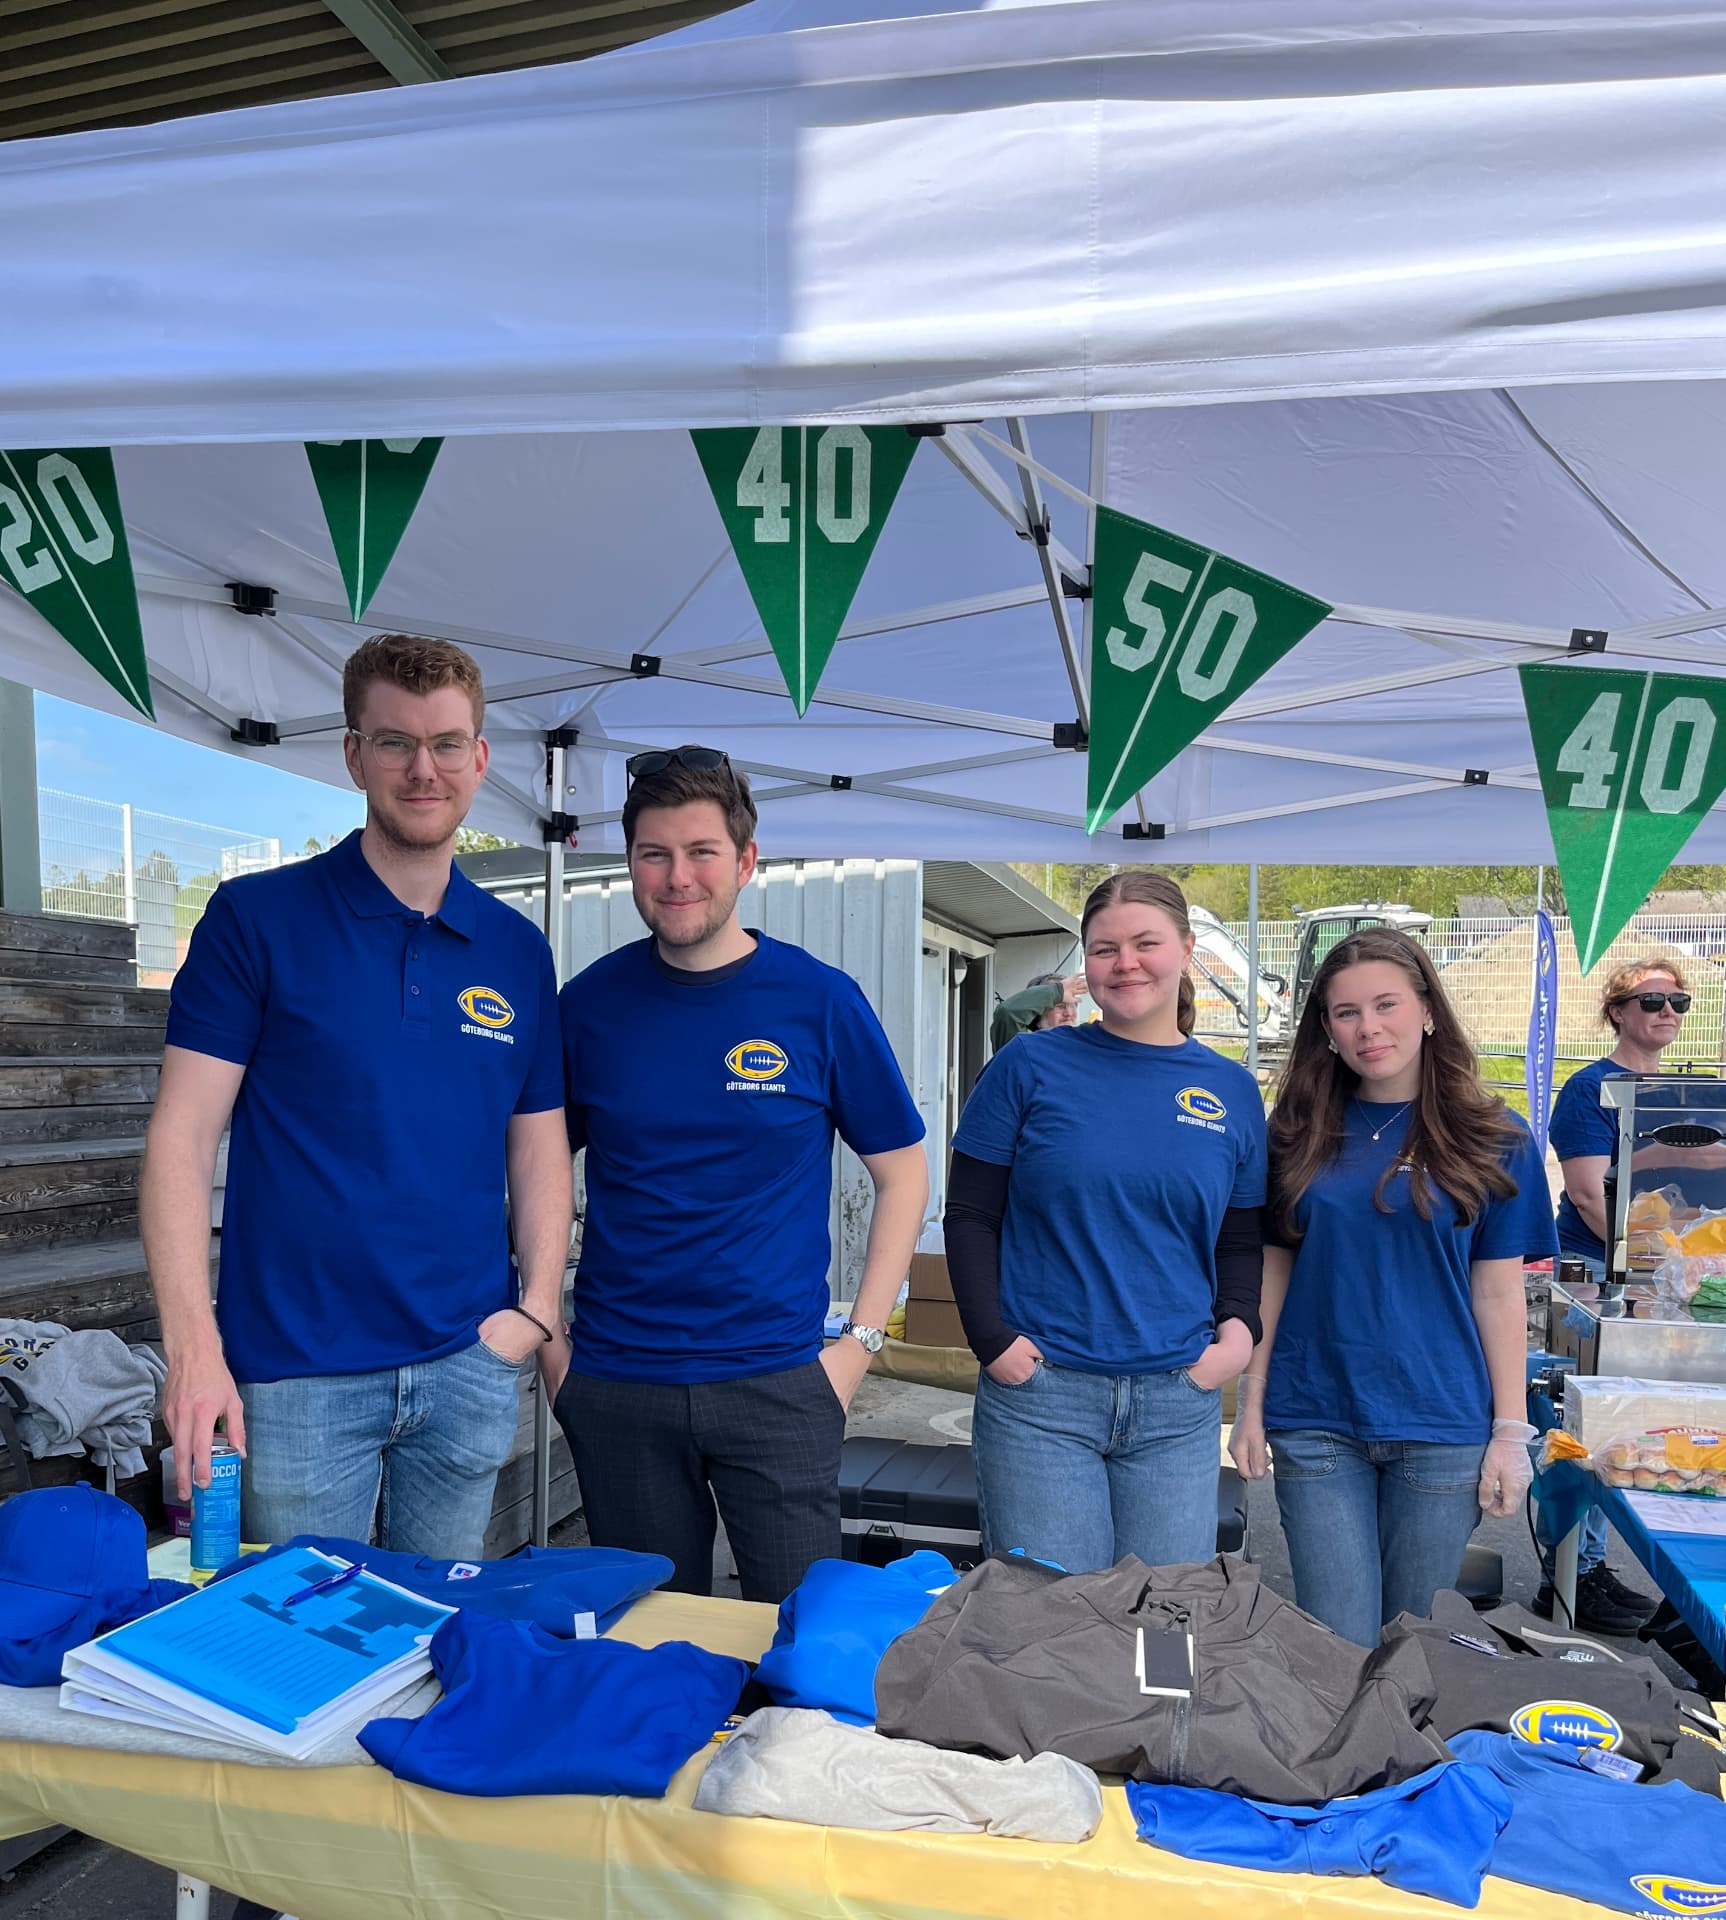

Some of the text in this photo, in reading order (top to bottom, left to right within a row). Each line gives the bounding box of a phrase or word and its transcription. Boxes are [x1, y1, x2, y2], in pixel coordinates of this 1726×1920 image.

[0, 452, 115, 594] 20
[736, 425, 872, 543] 40
[1105, 551, 1258, 702] 50
[1556, 691, 1717, 815] 40
[461, 1023, 514, 1045] GÖTEBORG GIANTS
[726, 1080, 786, 1093] GÖTEBORG GIANTS
[212, 1463, 237, 1478] OCCO
